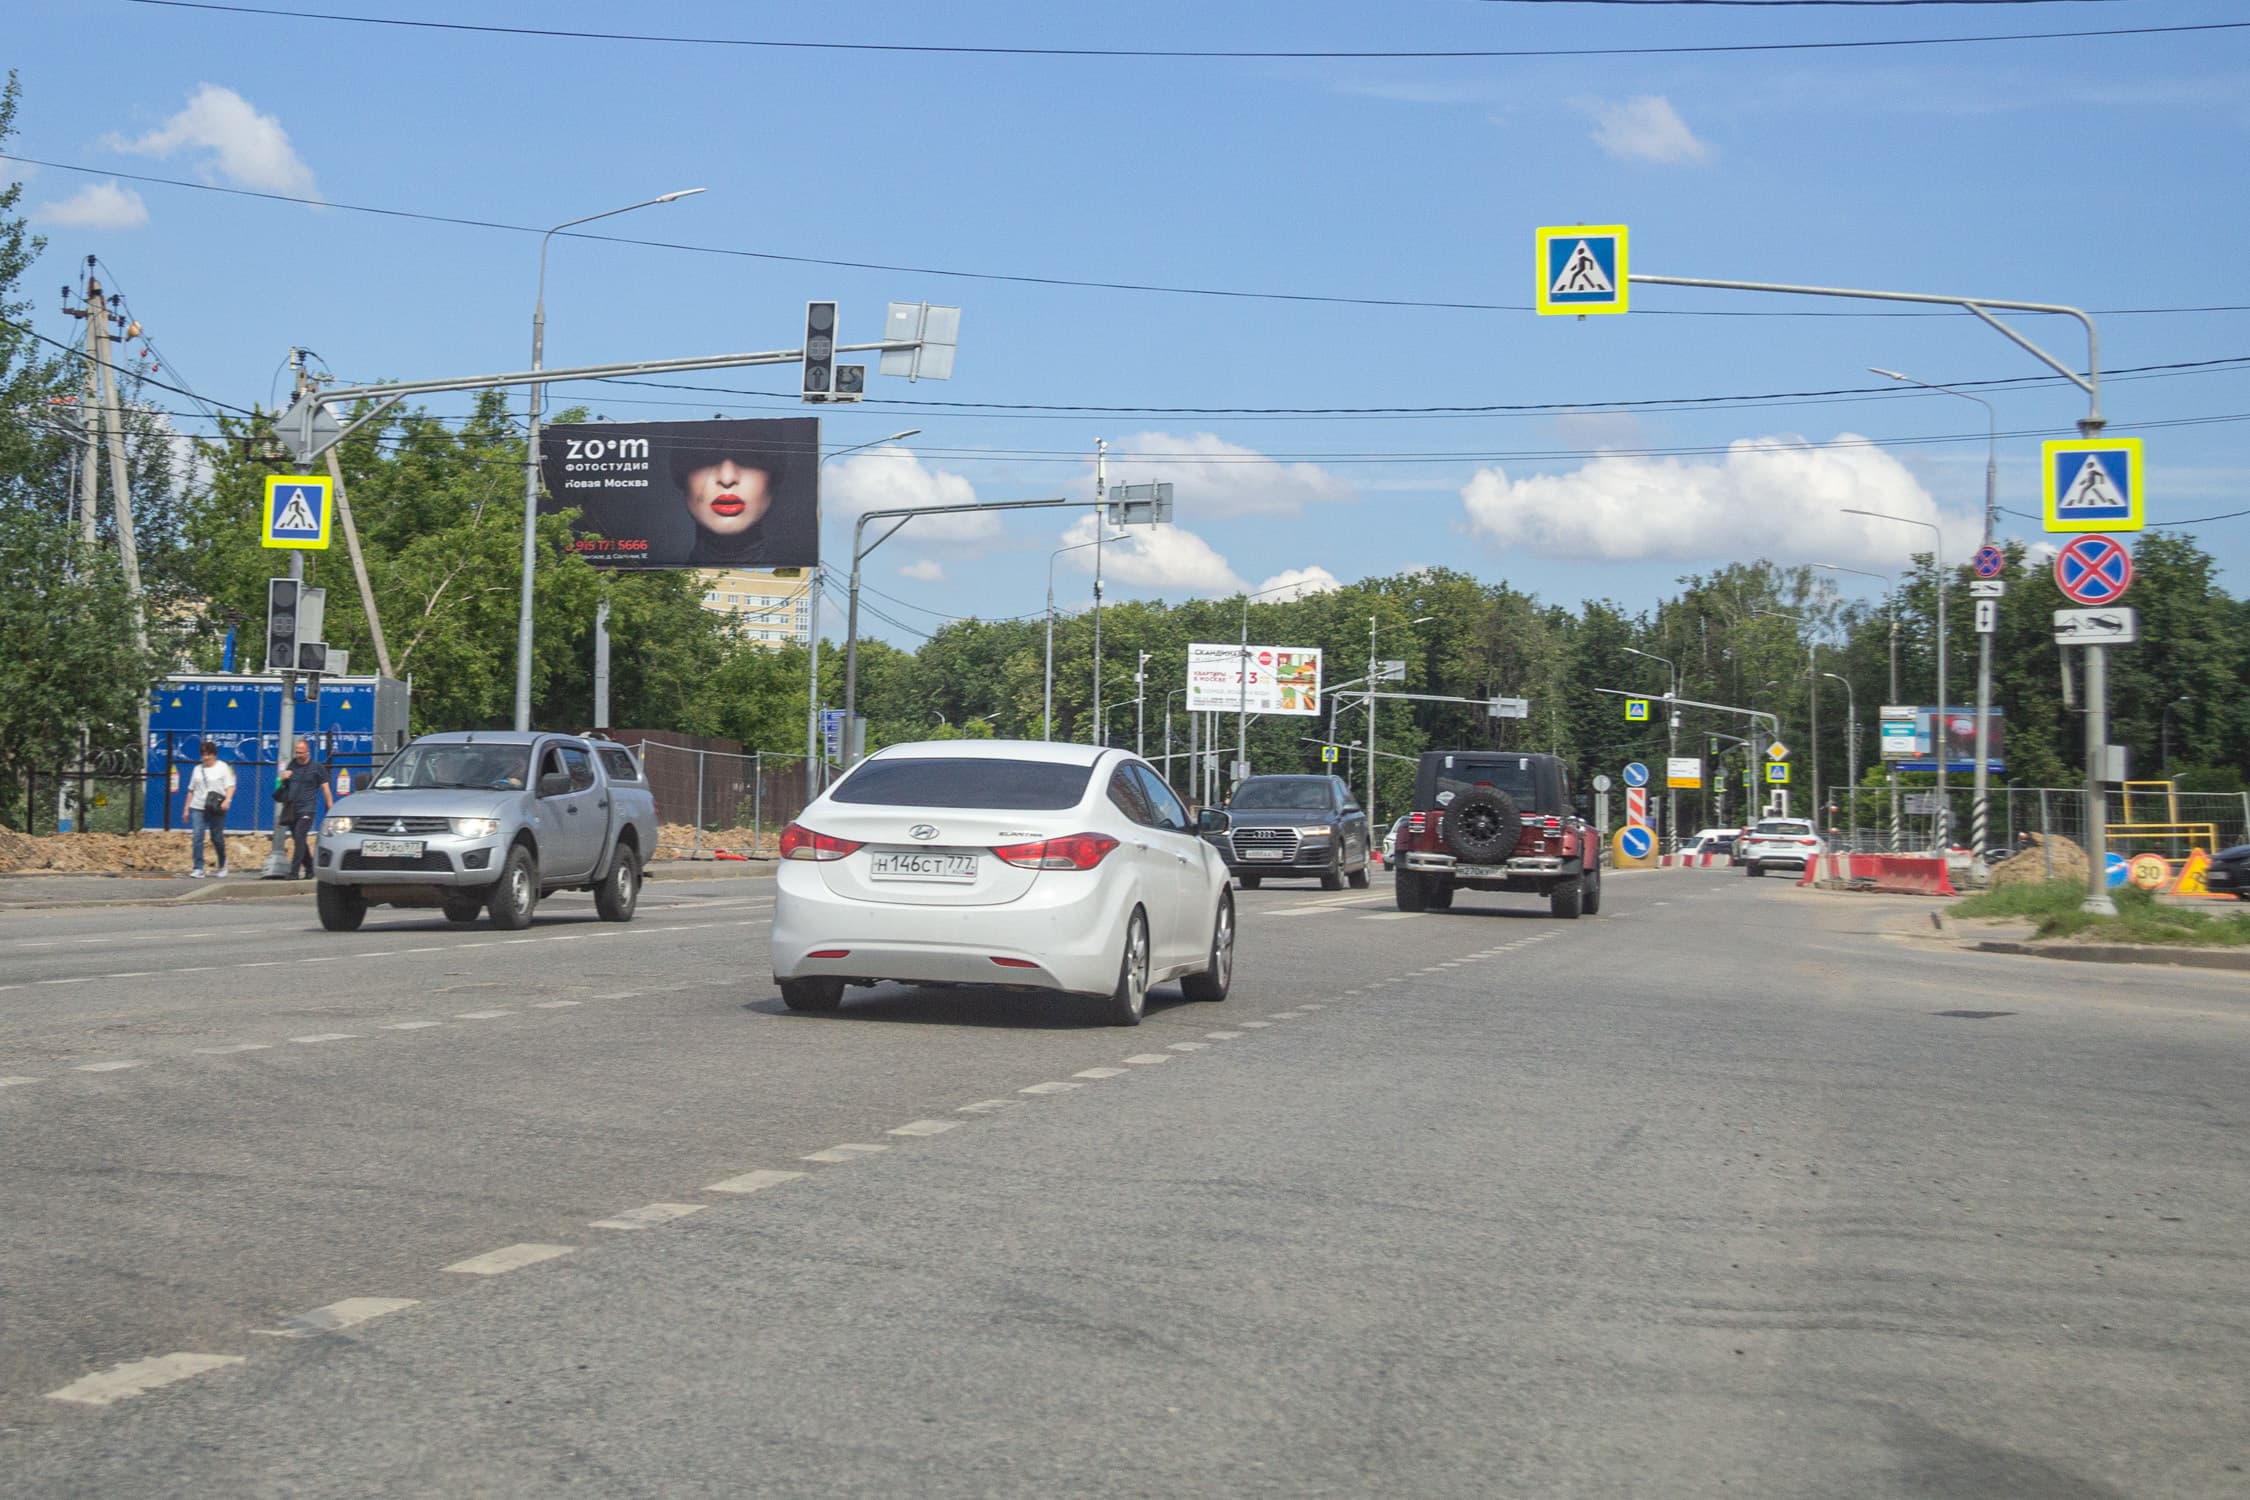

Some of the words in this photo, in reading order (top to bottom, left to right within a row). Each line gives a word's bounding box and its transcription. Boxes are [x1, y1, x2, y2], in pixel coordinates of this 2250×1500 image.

[565, 462, 649, 471] ФОТОСТУДИЯ
[604, 478, 649, 487] Москва
[618, 540, 649, 551] 5666
[2135, 865, 2160, 879] 30
